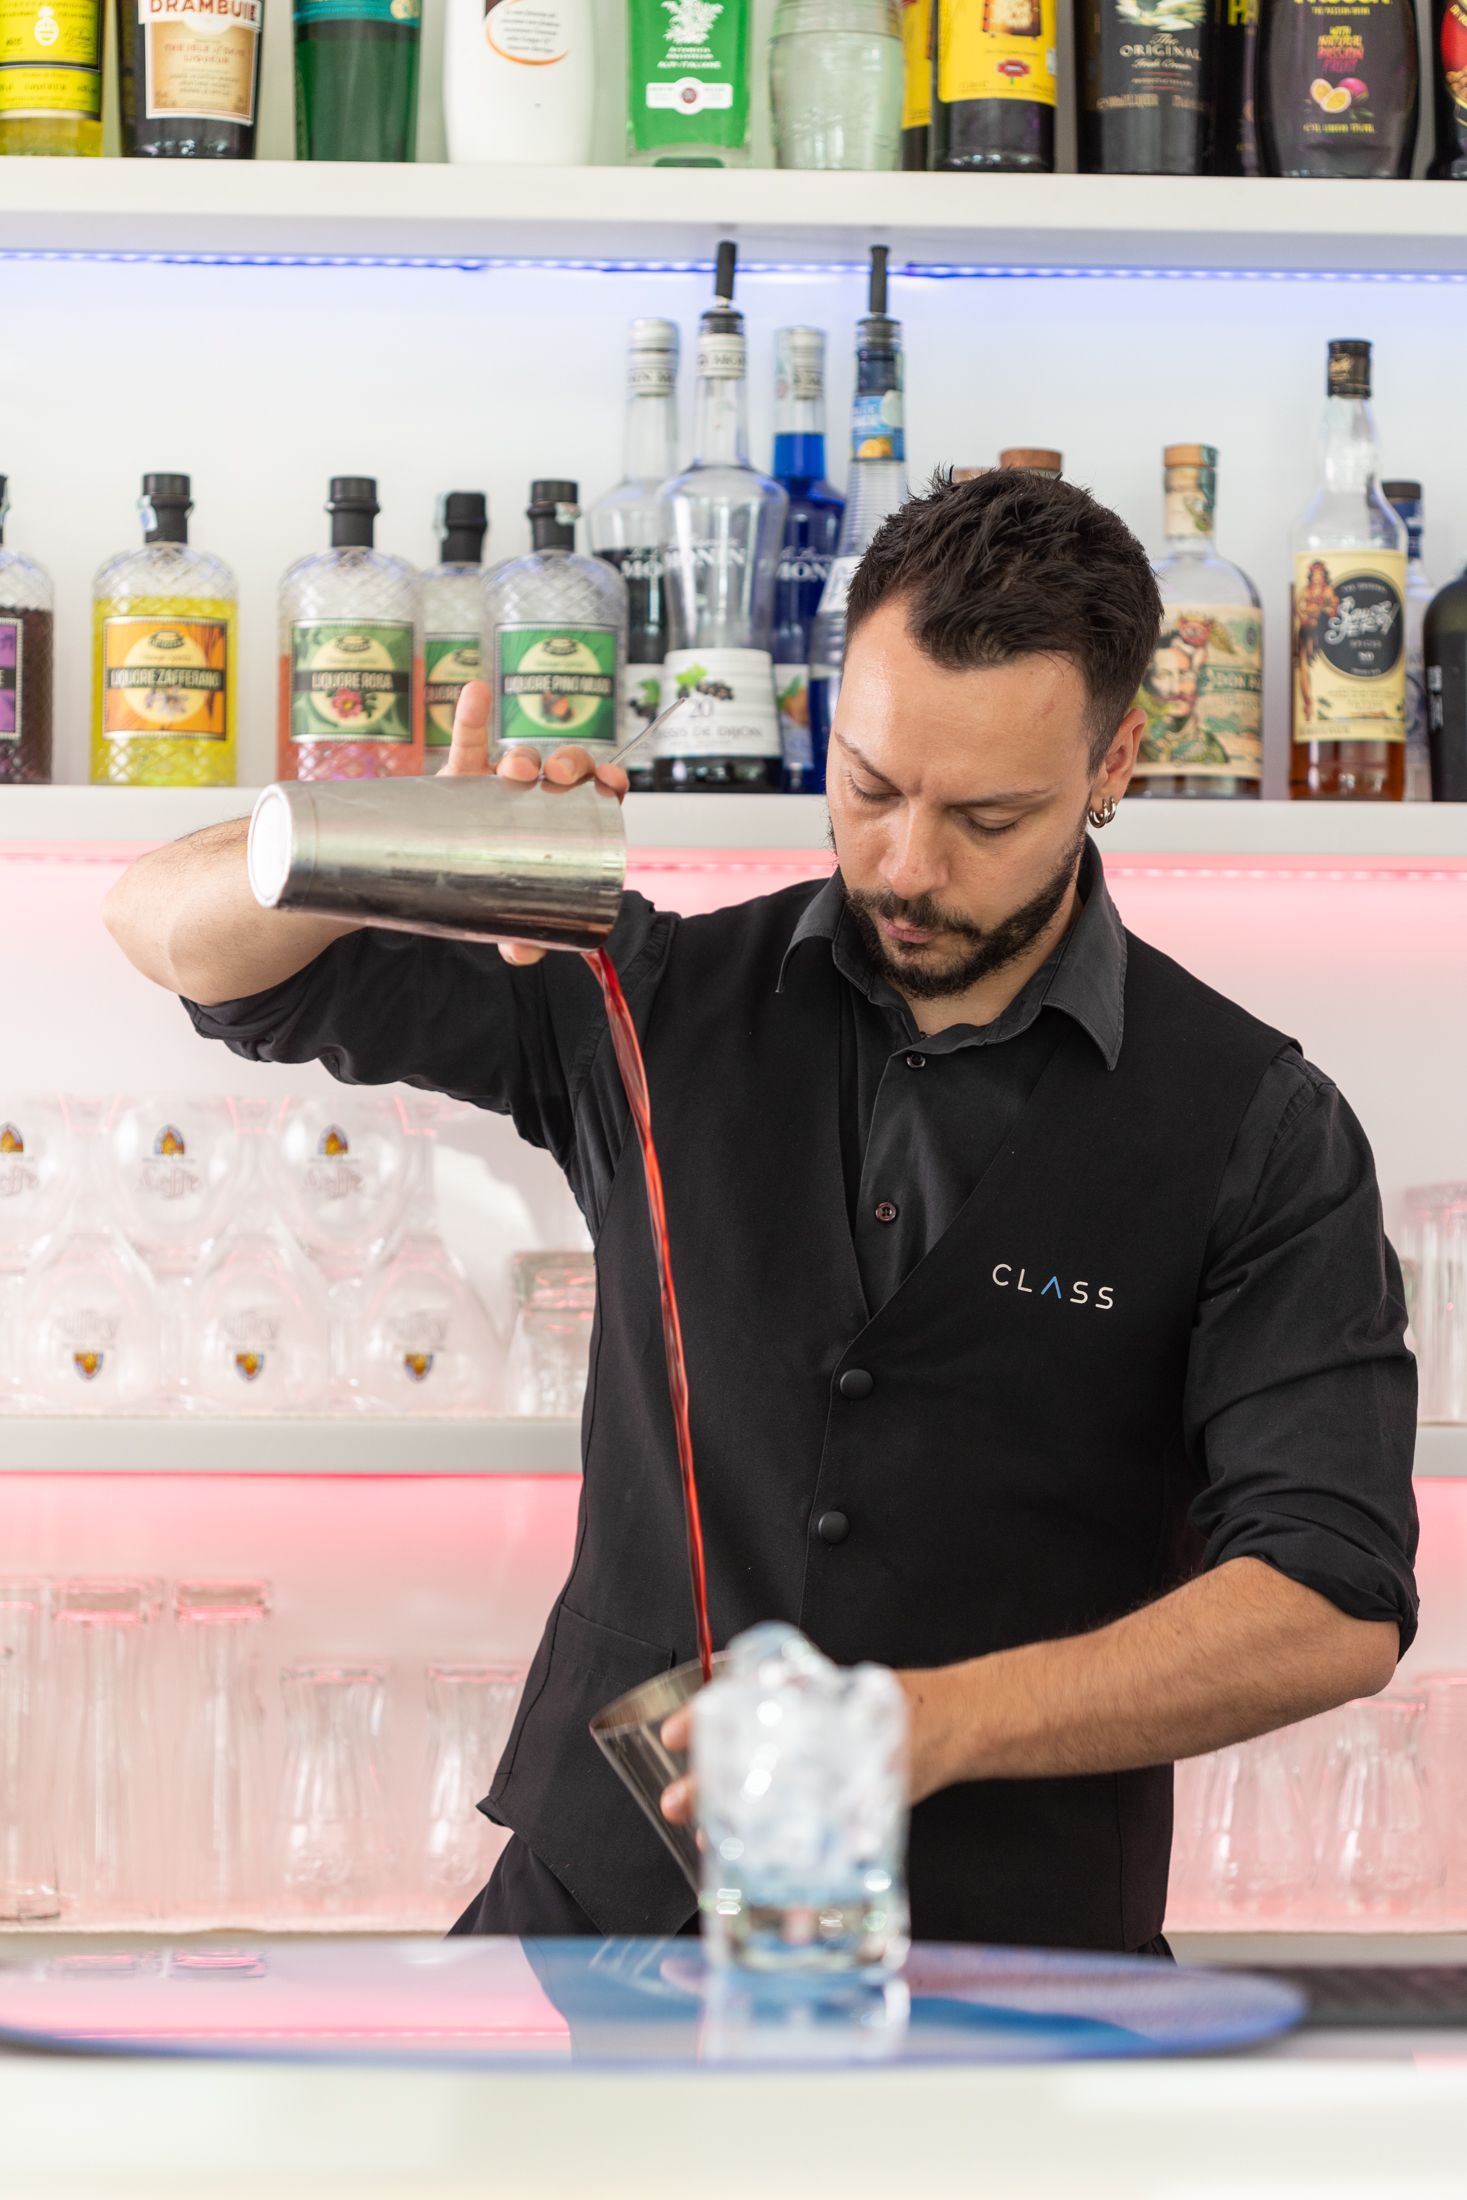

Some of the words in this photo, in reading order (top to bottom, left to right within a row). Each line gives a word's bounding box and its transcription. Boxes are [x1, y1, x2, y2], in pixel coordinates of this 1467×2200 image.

[150, 0, 257, 21] DRAMBUIE
[1119, 44, 1201, 61] ORIGINAL
[155, 668, 221, 691] ZAFFERANO
[311, 671, 360, 689] LIQUORE
[361, 671, 394, 690] ROSA
[503, 674, 551, 695] LIQUORE
[992, 1263, 1114, 1310] CLASS
